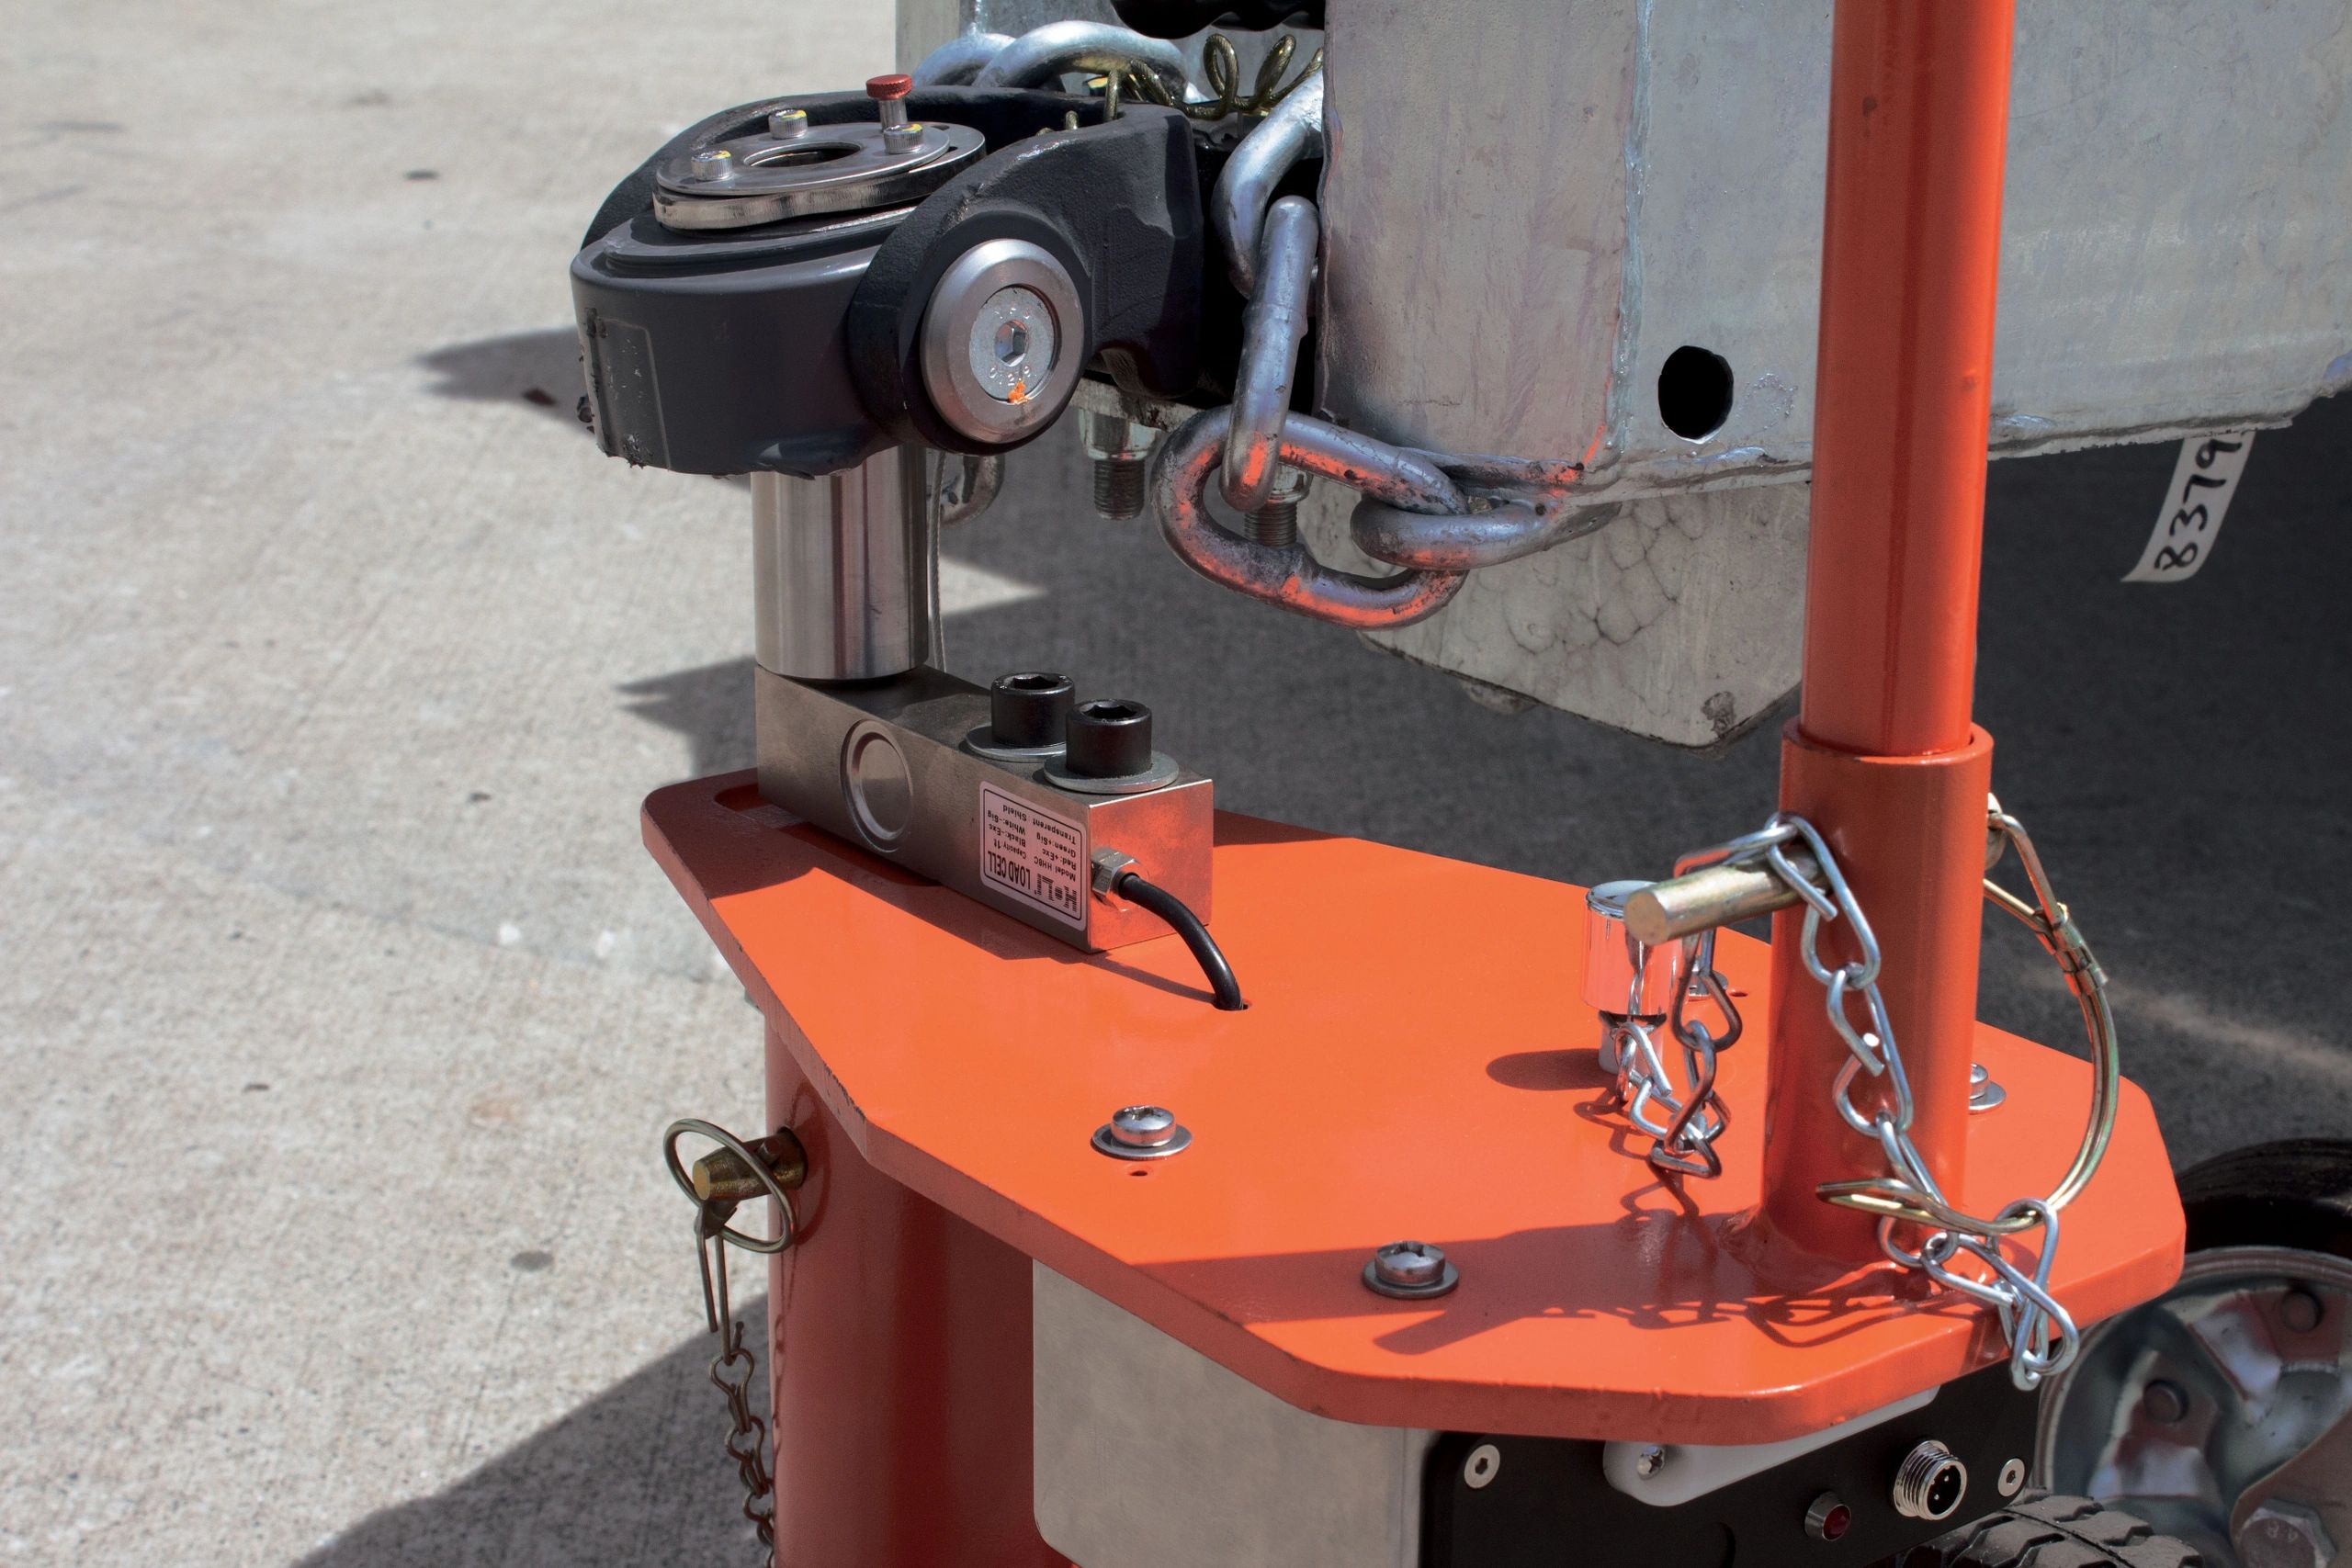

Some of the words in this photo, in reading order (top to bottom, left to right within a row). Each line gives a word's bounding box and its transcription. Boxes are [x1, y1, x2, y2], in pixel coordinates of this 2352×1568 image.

[2154, 438, 2243, 571] 8379
[1002, 805, 1027, 822] Shield
[1033, 818, 1077, 845] Transparent
[988, 851, 1007, 879] CELL
[1009, 861, 1031, 890] LOAD
[1056, 866, 1077, 882] Model
